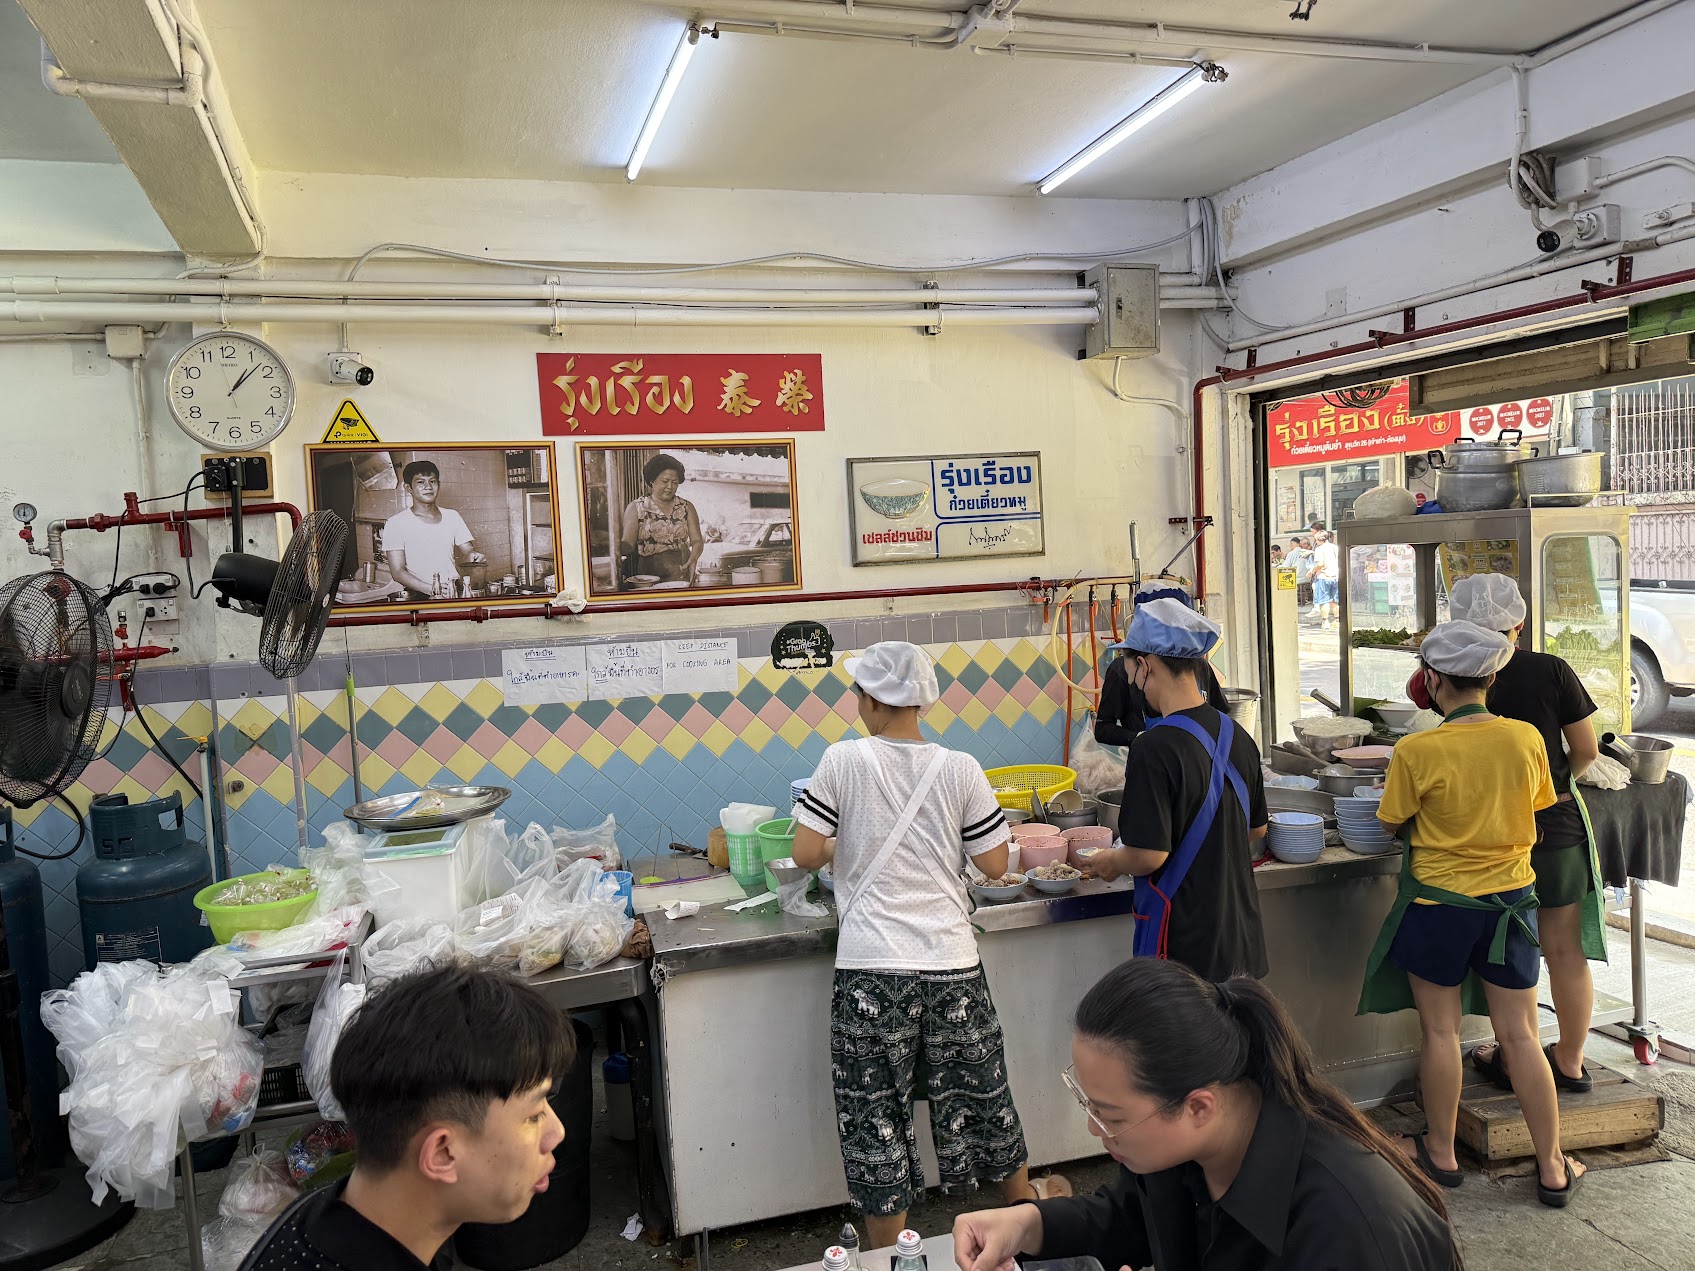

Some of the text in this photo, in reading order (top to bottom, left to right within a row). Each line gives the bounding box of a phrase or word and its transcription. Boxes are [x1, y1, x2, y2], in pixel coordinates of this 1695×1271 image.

[200, 350, 212, 363] 11
[220, 346, 236, 358] 12
[248, 350, 254, 363] 1
[183, 366, 201, 379] 10
[262, 366, 274, 378] 2
[181, 386, 193, 399] 9
[270, 386, 282, 399] 3
[552, 356, 695, 433] รุ่งเรือง
[190, 406, 202, 419] 8
[264, 406, 276, 418] 4
[1500, 410, 1520, 418] MICHELIN
[1528, 406, 1551, 414] MICHELIN
[1472, 414, 1492, 422] MICHELIN
[208, 422, 220, 434] 7
[229, 426, 241, 439] 6
[250, 420, 262, 434] 5
[1275, 404, 1381, 451] รุ่งเรือง
[940, 460, 1032, 494] รุ่งเรือง
[949, 489, 1027, 511] ก๋วยเตี๋ยวหมู
[862, 527, 933, 544] เชลล์ชวนชิม
[678, 642, 728, 650] KEEP DISTANCE
[682, 660, 708, 668] COOKING
